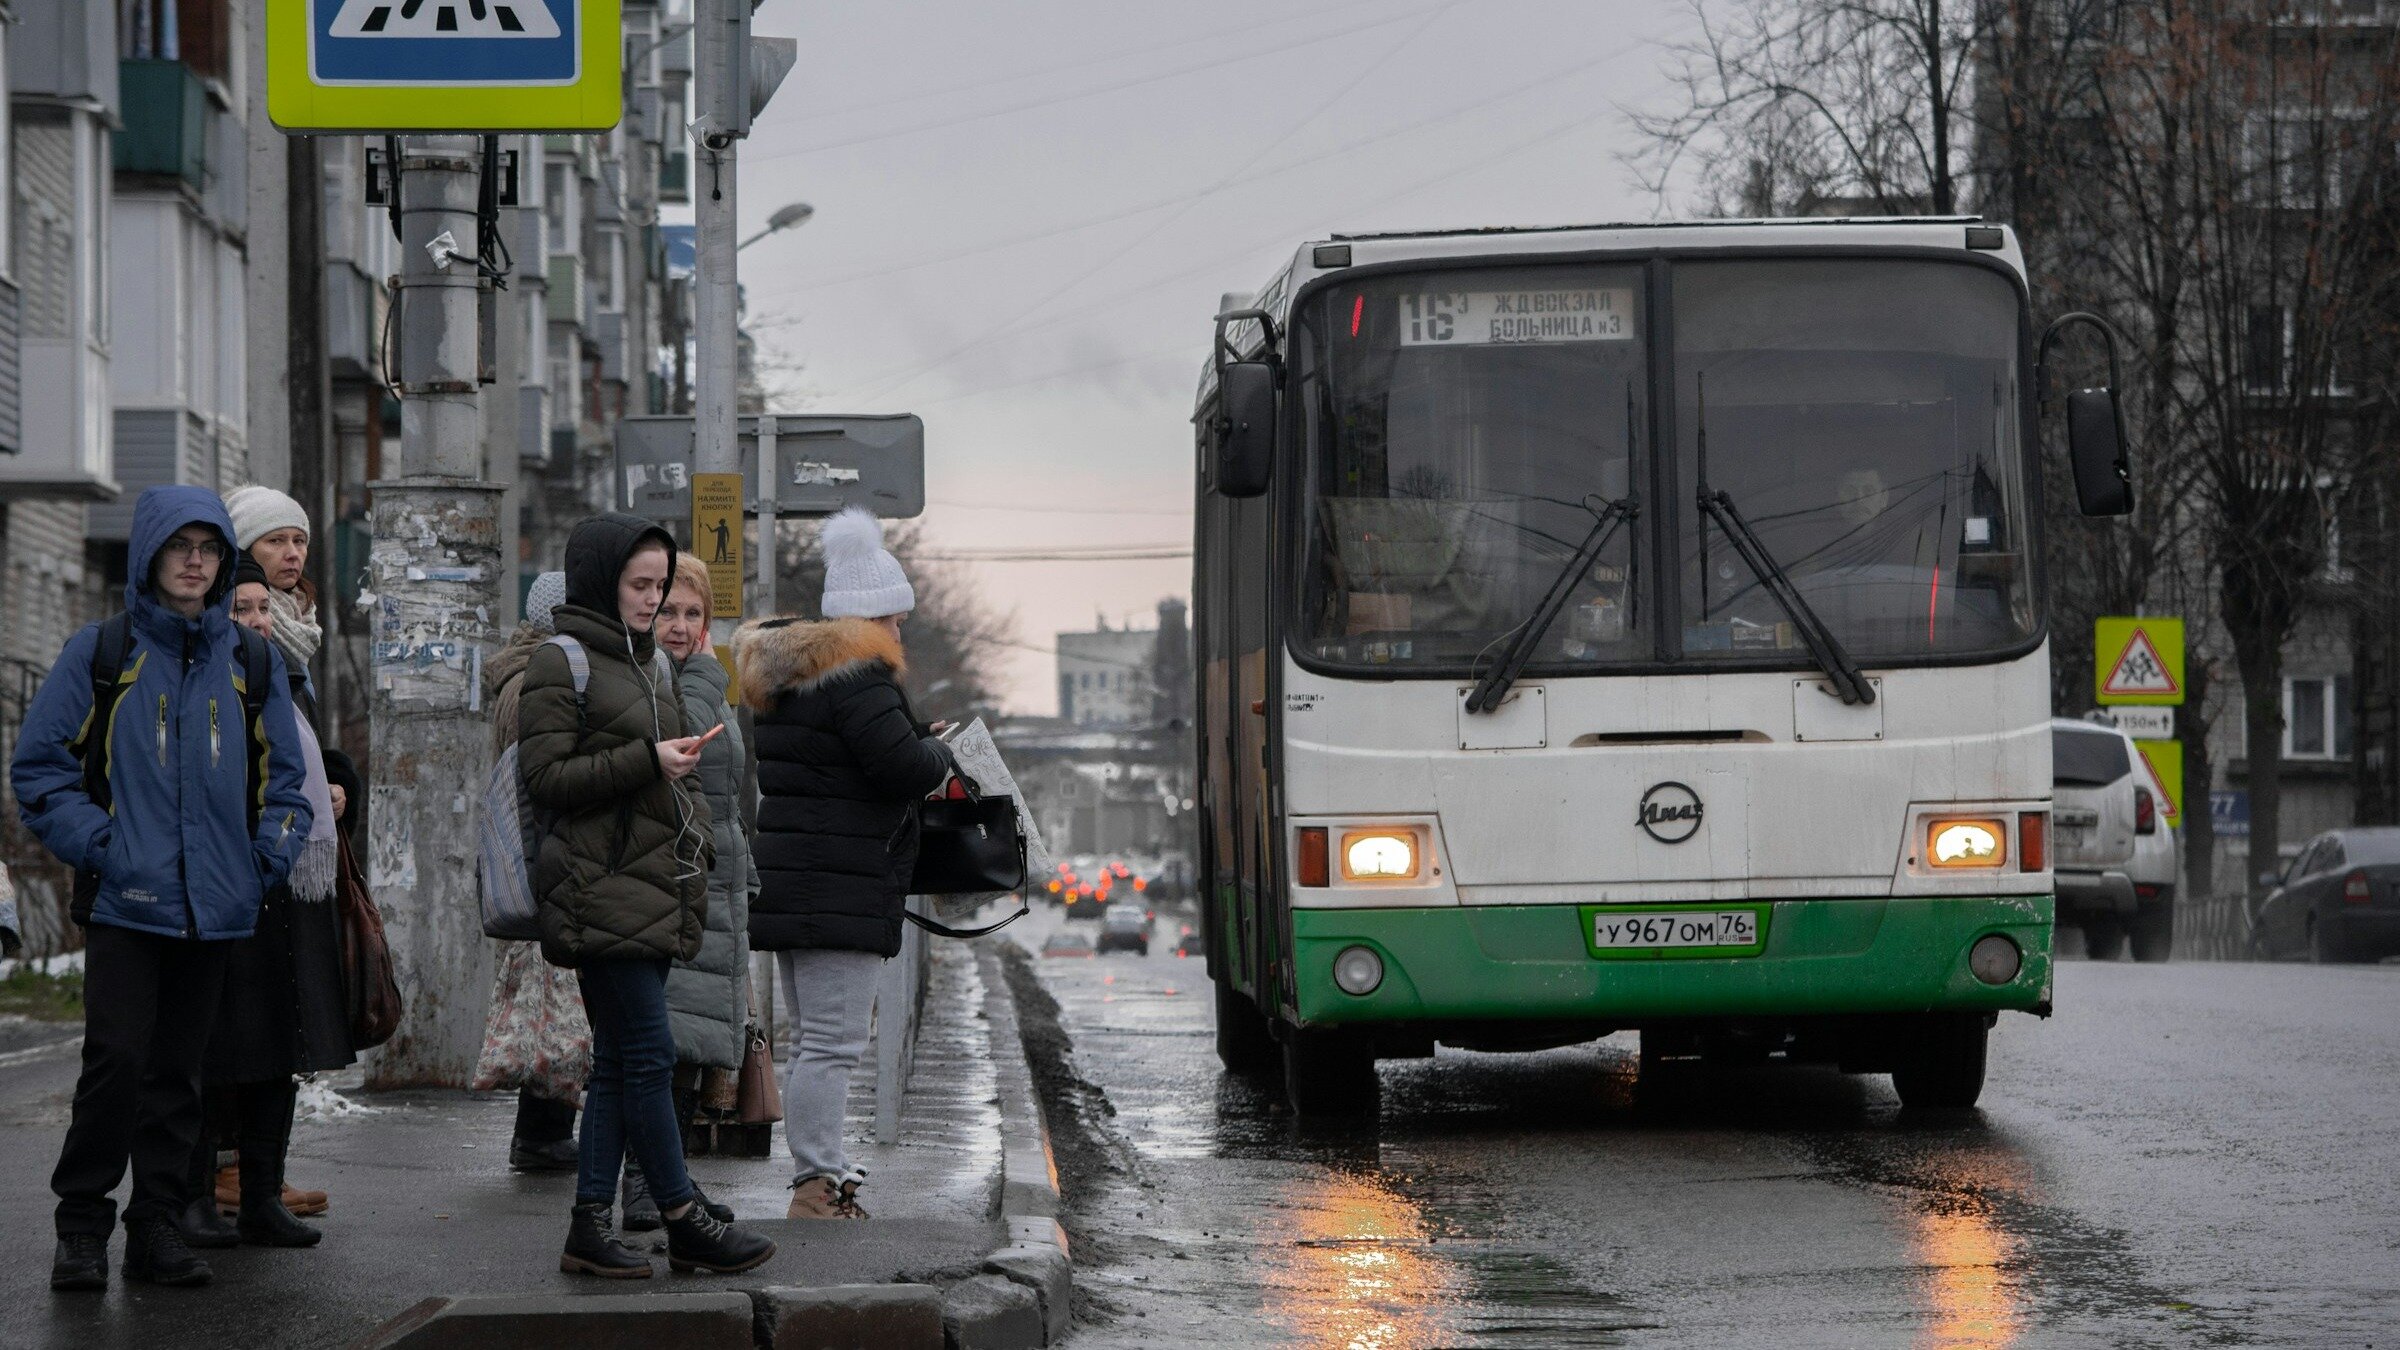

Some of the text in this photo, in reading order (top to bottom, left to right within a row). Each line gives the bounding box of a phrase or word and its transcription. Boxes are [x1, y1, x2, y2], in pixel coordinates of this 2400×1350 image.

[1489, 316, 1592, 338] БОЛЬНИЦА
[697, 495, 737, 503] НАЖМИТЕ
[1720, 915, 1747, 934] 76
[1718, 934, 1738, 942] RUS
